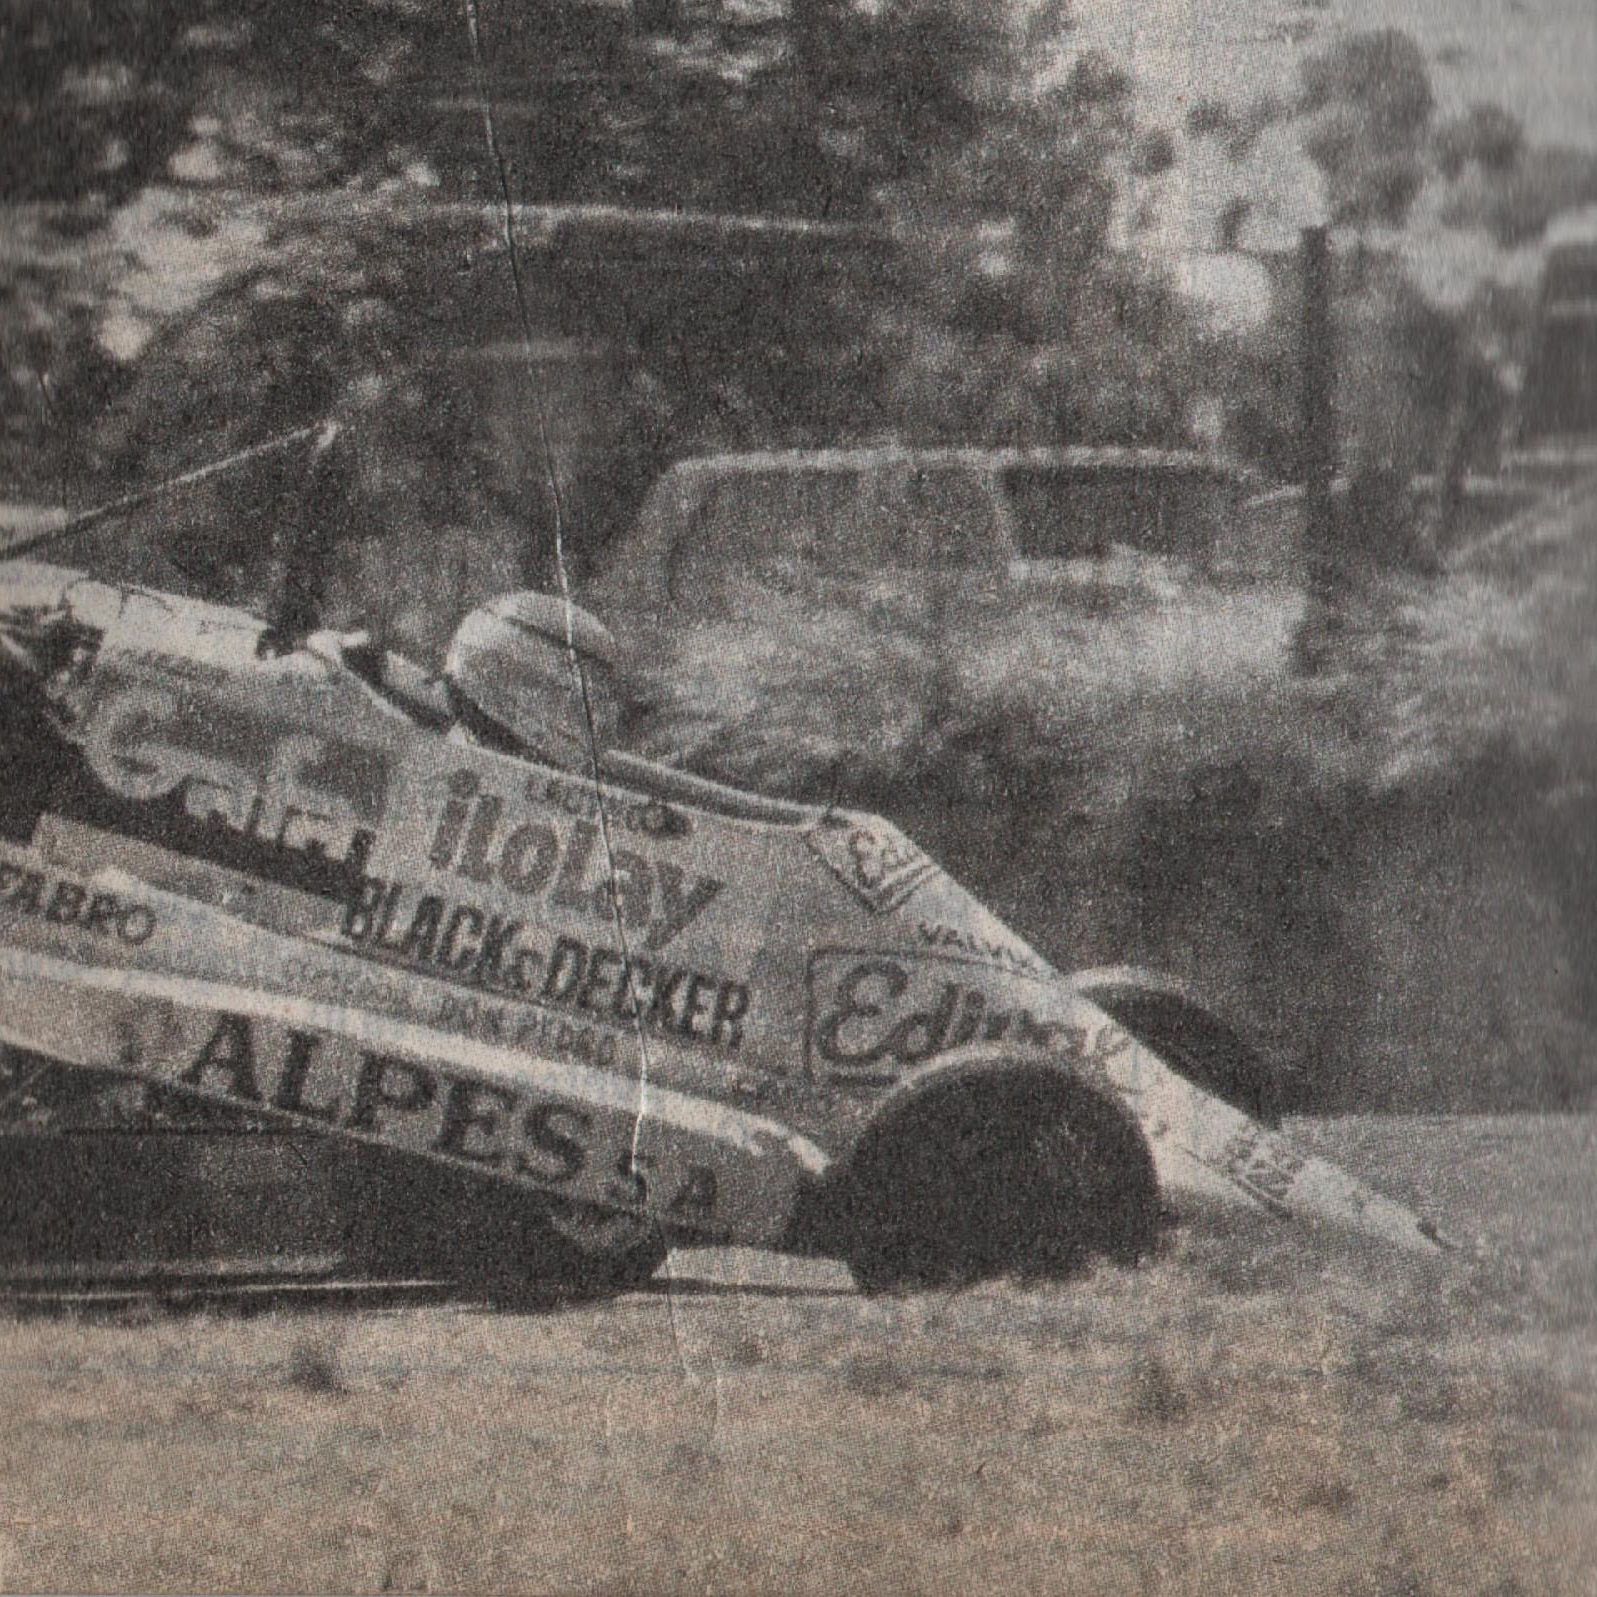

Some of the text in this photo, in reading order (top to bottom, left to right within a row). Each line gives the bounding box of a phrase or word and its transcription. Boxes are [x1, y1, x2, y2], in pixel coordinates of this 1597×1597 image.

[340, 877, 524, 985] BLACK
[541, 936, 751, 1050] DECKER
[184, 1010, 593, 1186] ALPES
